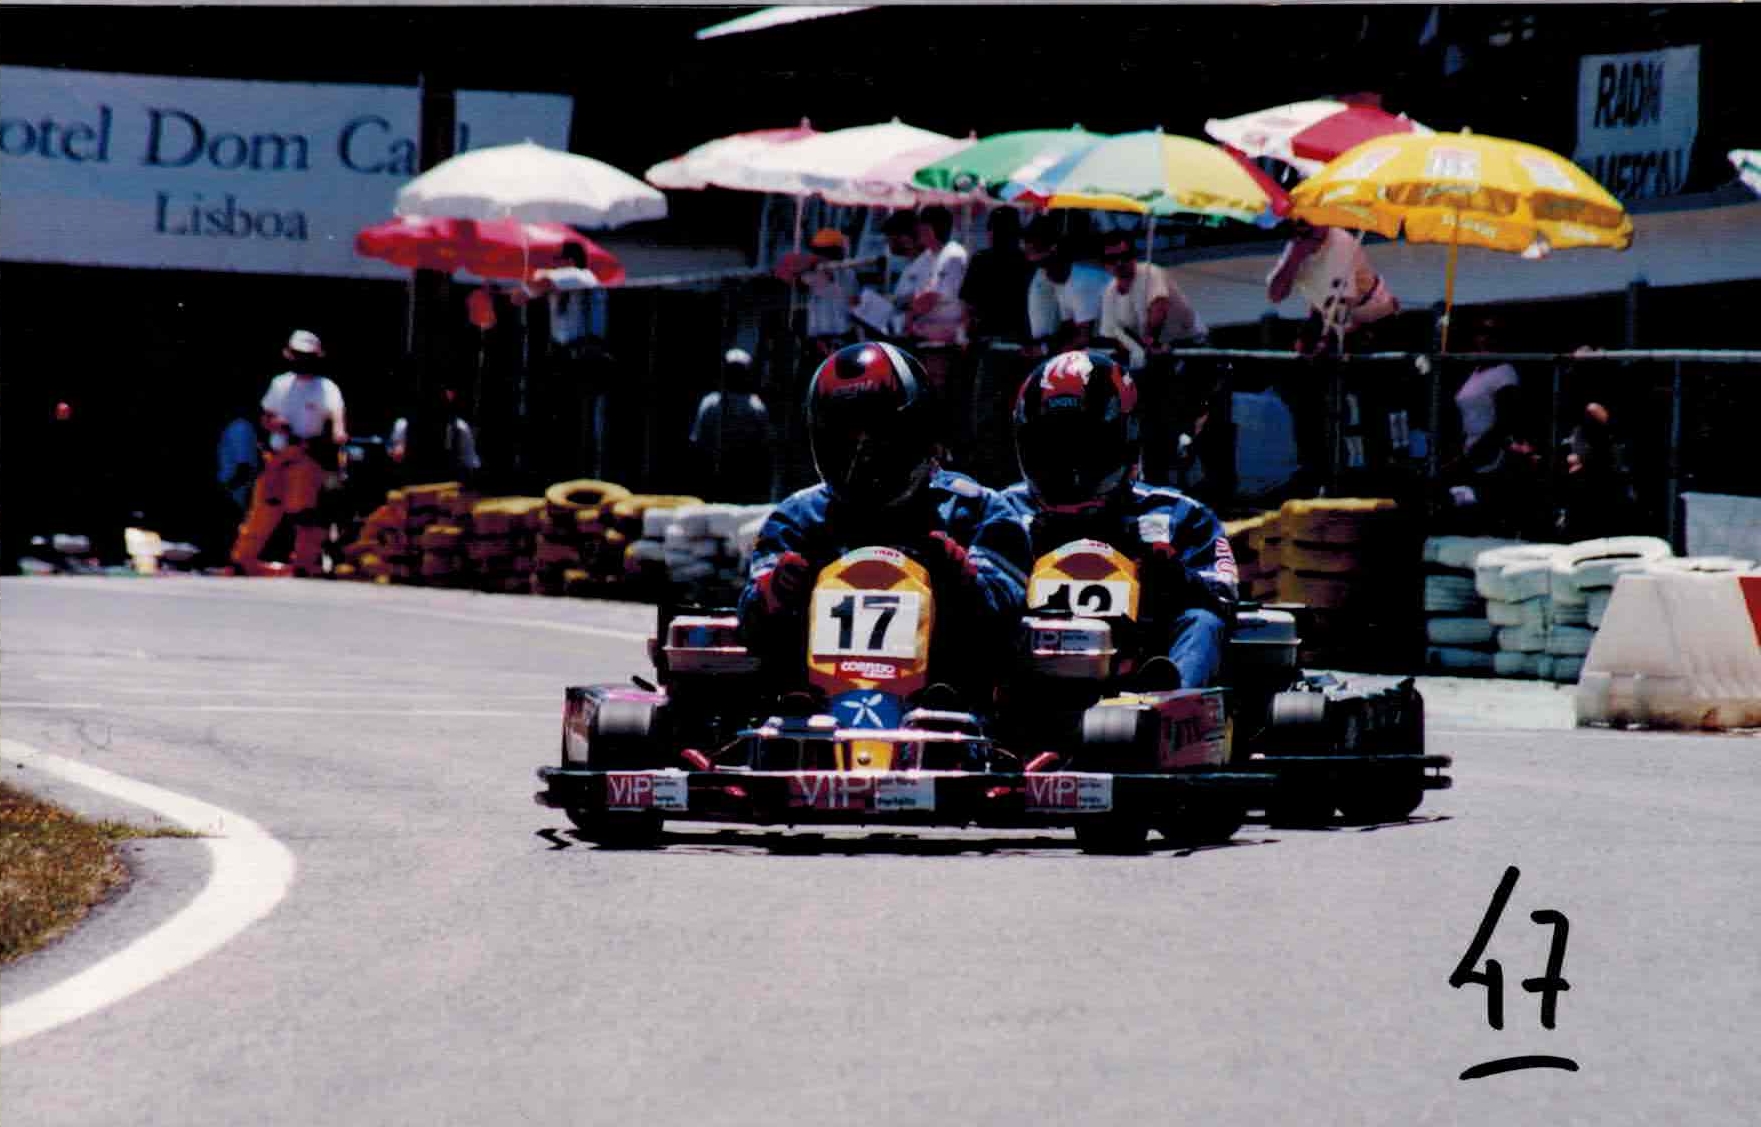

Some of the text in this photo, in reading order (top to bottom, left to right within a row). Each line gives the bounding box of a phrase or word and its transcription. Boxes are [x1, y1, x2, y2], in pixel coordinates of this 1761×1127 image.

[0, 103, 113, 164] otel
[139, 107, 311, 171] Dom
[155, 191, 309, 241] Lisboa
[830, 595, 900, 650] 17
[608, 775, 652, 805] VIP
[795, 774, 872, 808] VIP
[1031, 775, 1076, 806] VIP
[1449, 866, 1570, 1030] 47
